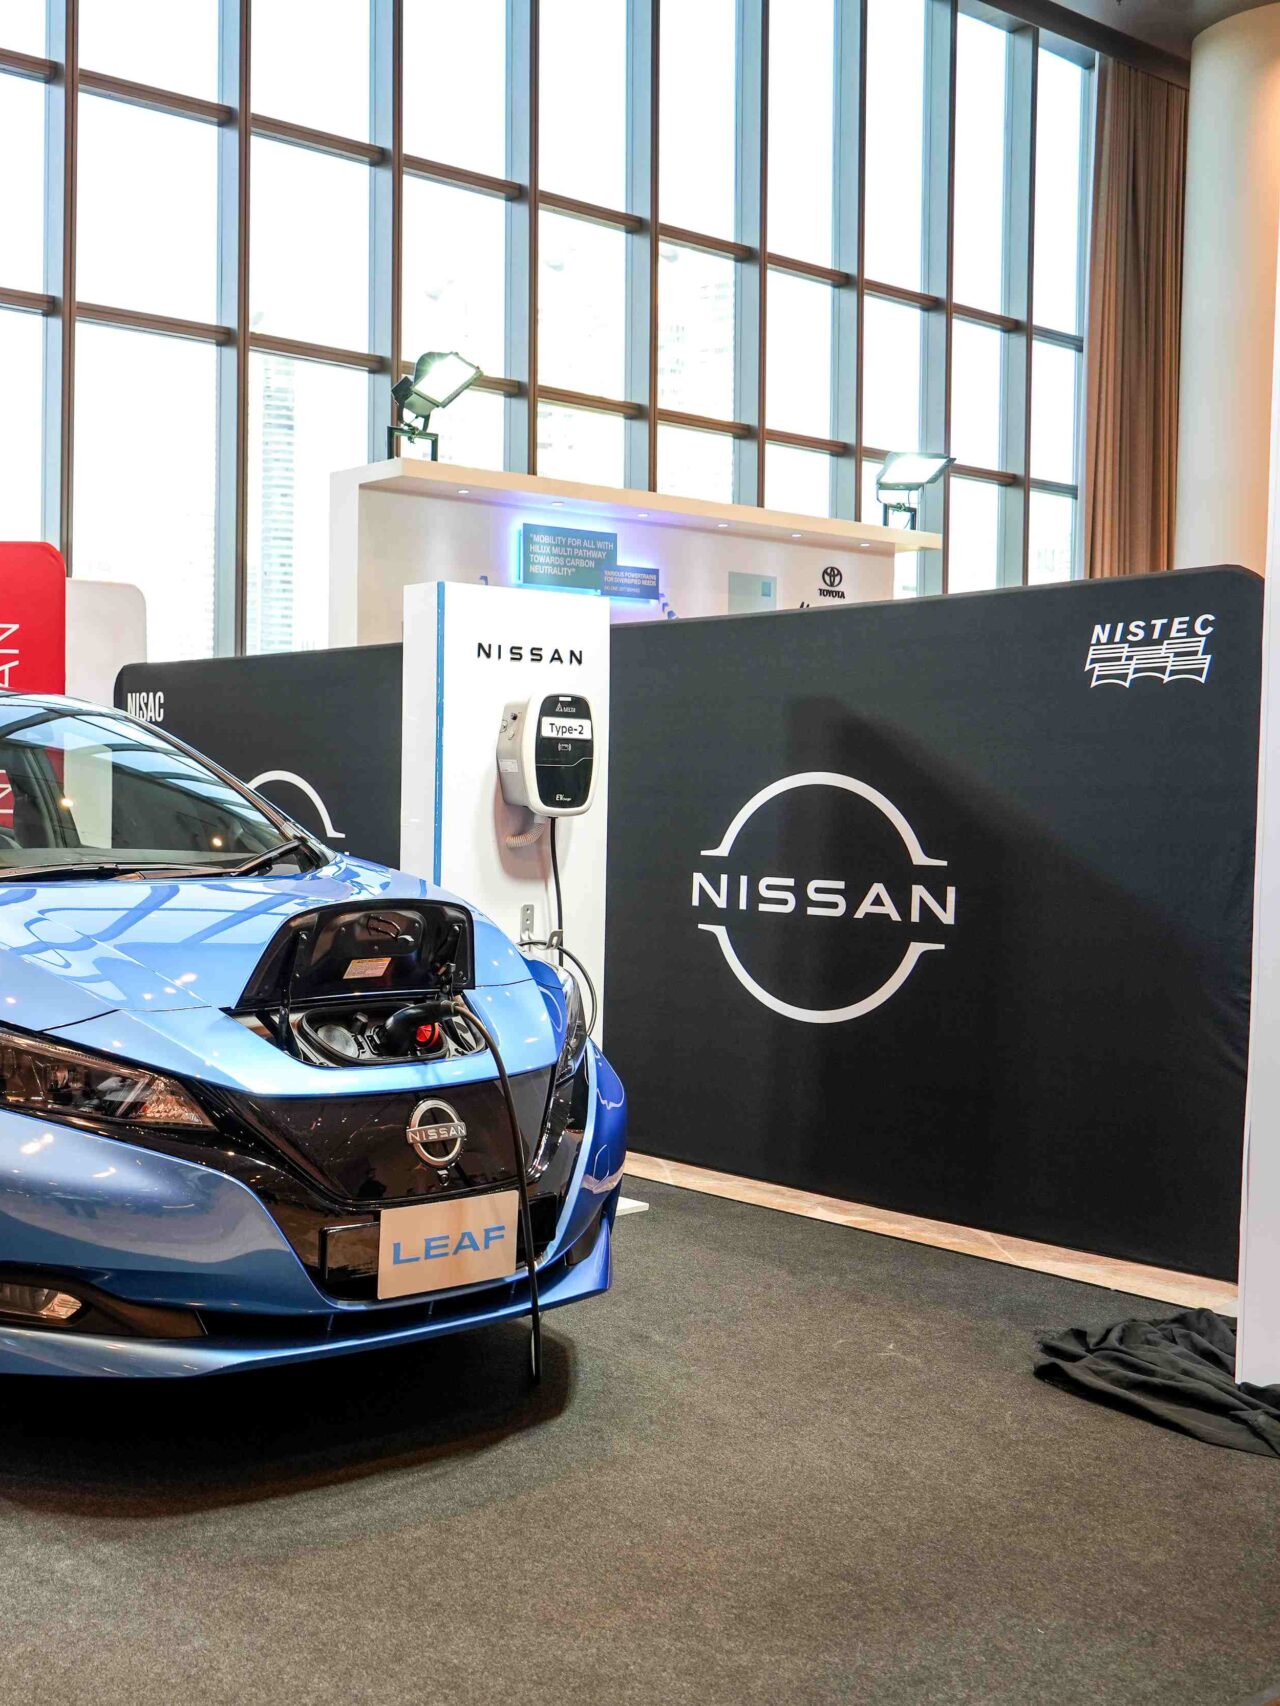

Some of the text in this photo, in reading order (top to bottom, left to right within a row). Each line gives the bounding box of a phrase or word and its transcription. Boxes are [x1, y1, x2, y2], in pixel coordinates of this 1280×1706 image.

[530, 544, 607, 559] HILUX MULTI PATHWAY
[567, 537, 582, 547] FOR
[583, 539, 595, 548] ALL
[596, 540, 614, 550] WITH
[530, 554, 595, 569] TOWARDS CARBON
[818, 588, 846, 599] TOYOTA
[1091, 613, 1216, 644] NISTEC
[477, 642, 583, 666] NISSAN
[127, 691, 165, 722] NISAC
[549, 722, 584, 736] Type-2
[691, 871, 957, 925] NISSAN
[408, 1125, 466, 1143] NISSAN
[392, 1225, 506, 1265] LEAF
